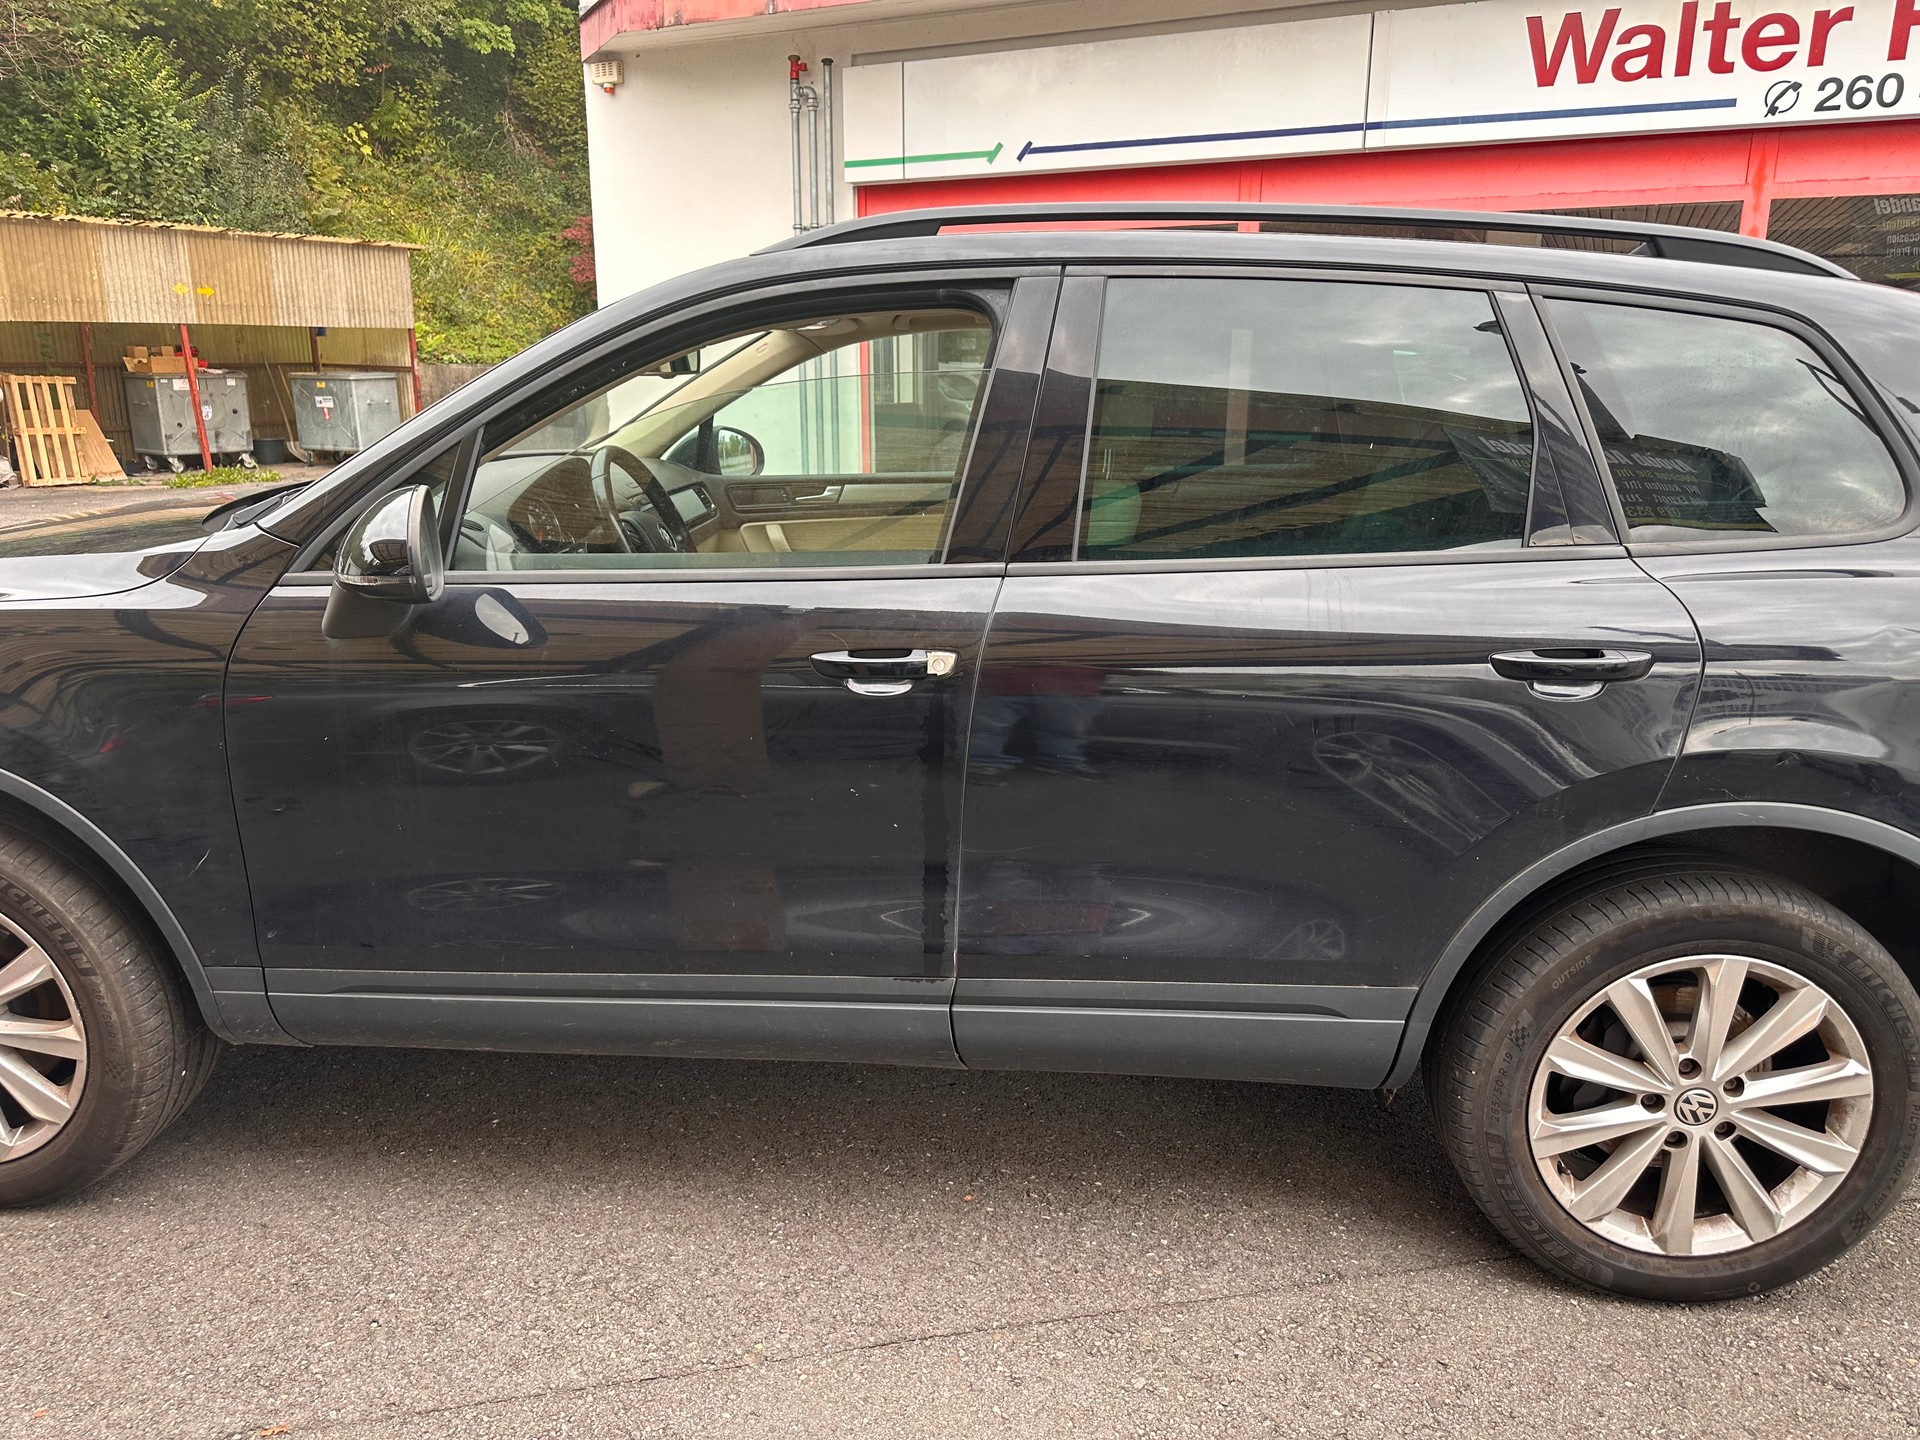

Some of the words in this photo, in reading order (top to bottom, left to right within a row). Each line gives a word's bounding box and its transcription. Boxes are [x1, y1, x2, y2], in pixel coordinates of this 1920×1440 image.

[1526, 1, 1854, 87] Walter
[1814, 72, 1904, 112] 260
[0, 879, 92, 969] ICHELIN
[1552, 954, 1593, 990] OUTSIDE
[1490, 1079, 1504, 1122] 265/50
[1498, 1066, 1507, 1078] R
[1503, 1051, 1513, 1066] 19
[1907, 1104, 1920, 1140] PILOT
[1889, 1145, 1912, 1185] SPORT
[1487, 1134, 1570, 1259] MICHELIN
